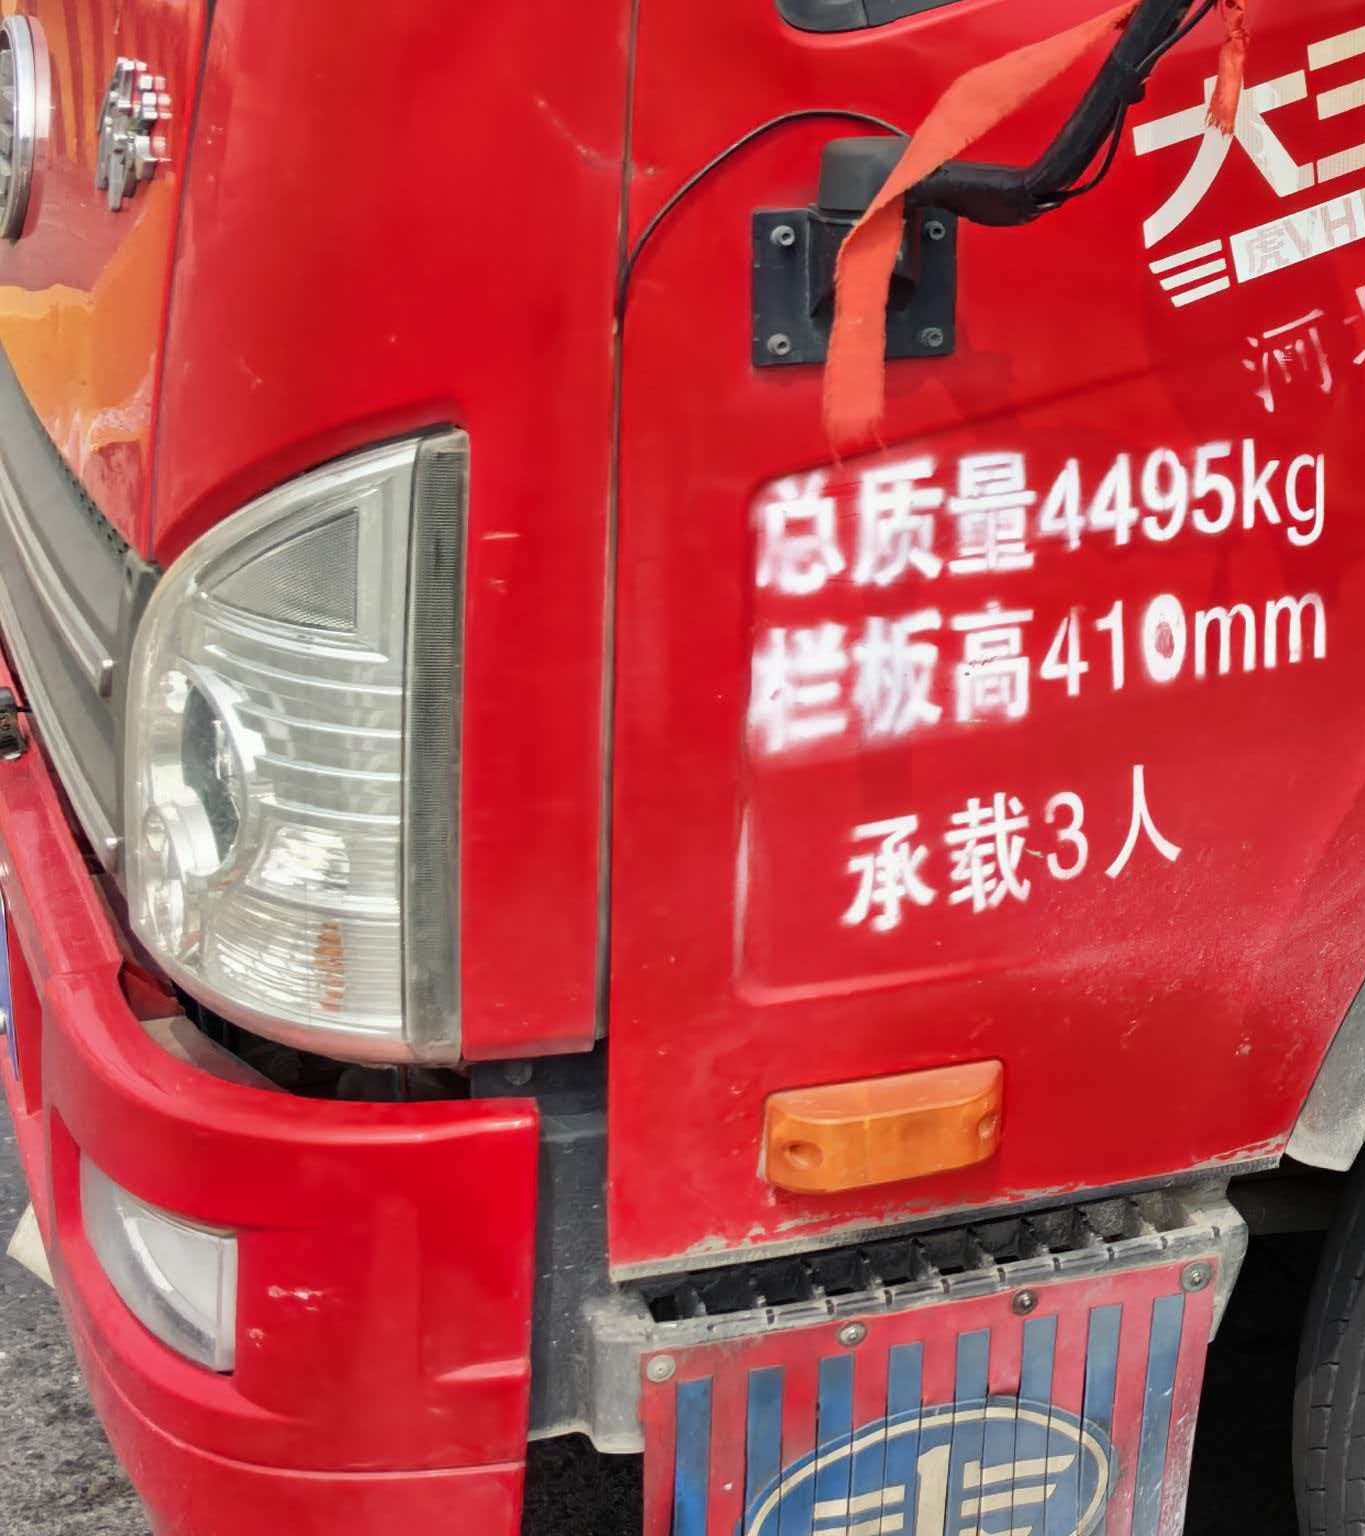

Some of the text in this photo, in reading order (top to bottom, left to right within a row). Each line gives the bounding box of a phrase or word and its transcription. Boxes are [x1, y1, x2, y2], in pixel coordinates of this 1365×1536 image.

[755, 438, 1326, 595] 总质量4495kg
[750, 592, 1328, 754] 栏板高410mm
[841, 764, 1182, 932] 承载3人
